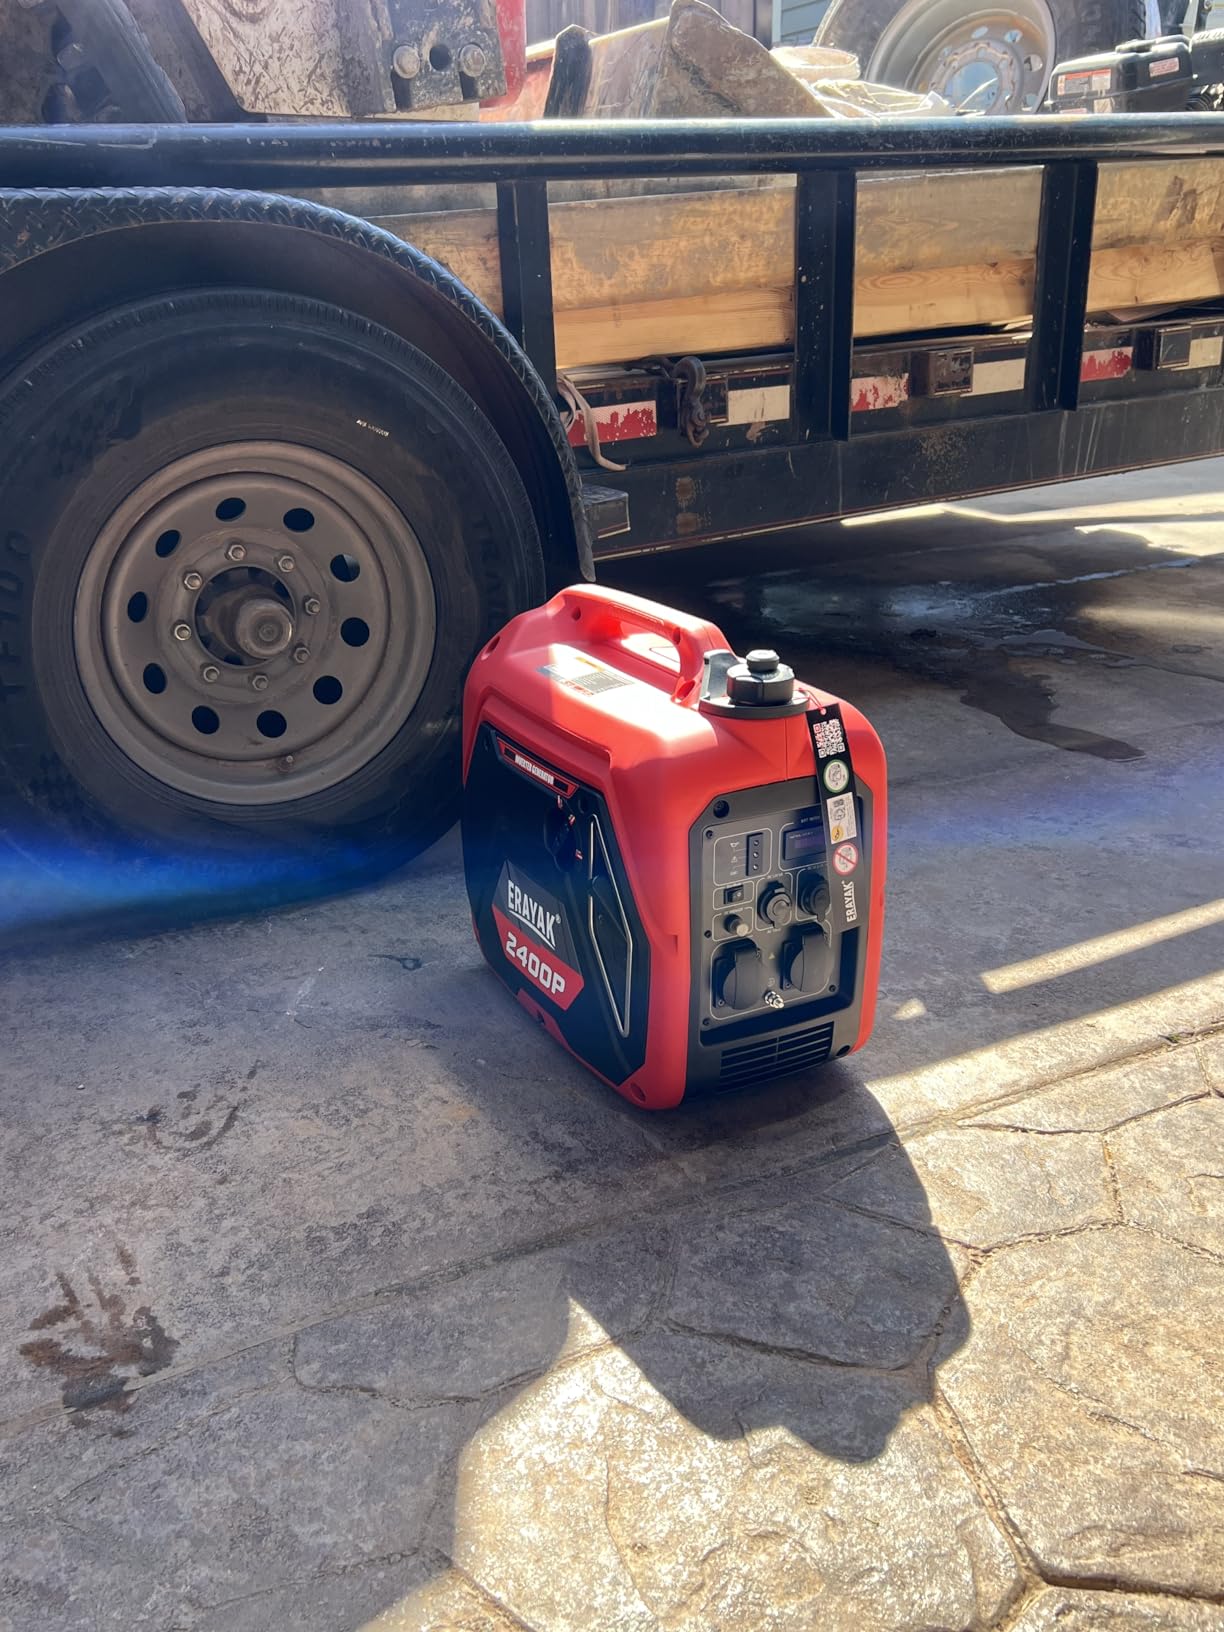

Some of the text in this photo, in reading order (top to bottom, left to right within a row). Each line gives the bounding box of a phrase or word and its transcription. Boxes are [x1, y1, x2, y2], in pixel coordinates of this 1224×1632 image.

[508, 879, 556, 948] ERAYAK
[843, 881, 857, 922] ERAYAK
[506, 932, 565, 994] 2400P
